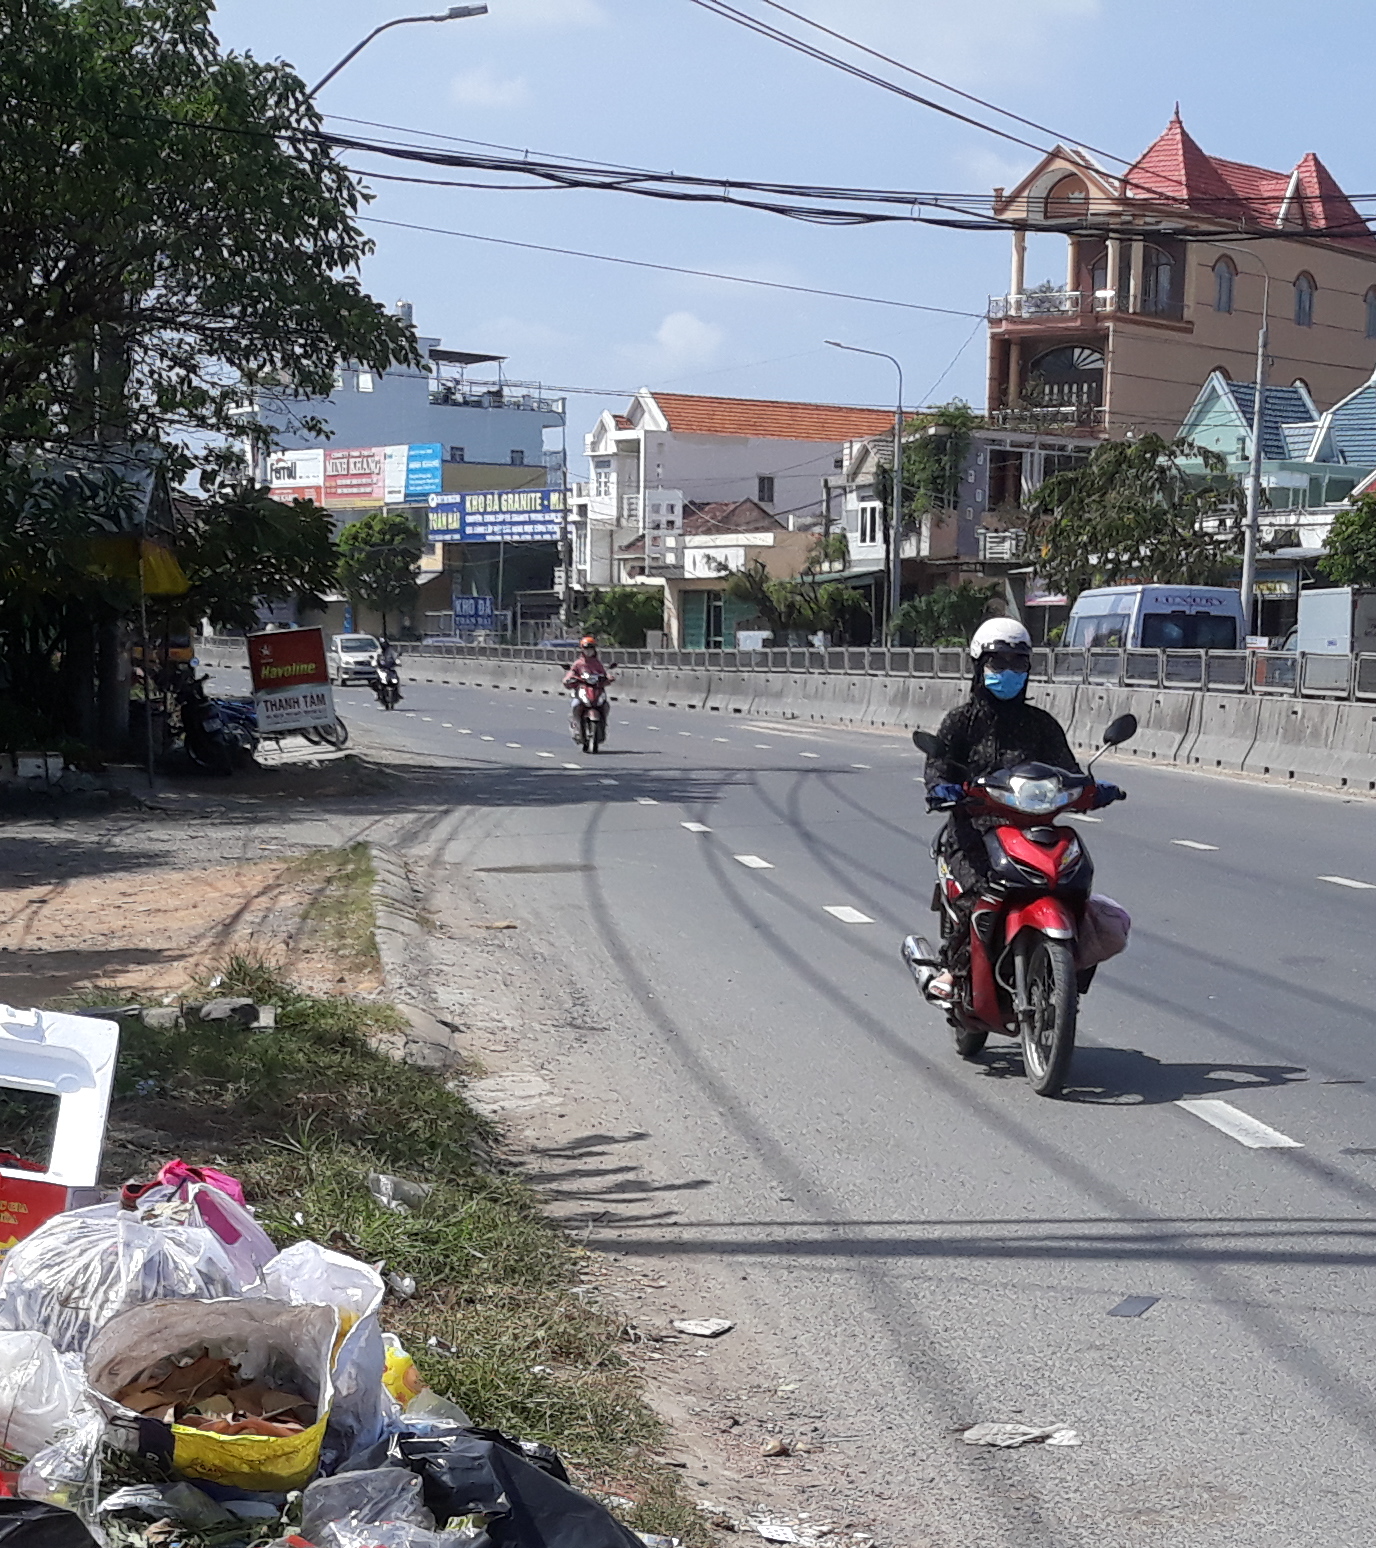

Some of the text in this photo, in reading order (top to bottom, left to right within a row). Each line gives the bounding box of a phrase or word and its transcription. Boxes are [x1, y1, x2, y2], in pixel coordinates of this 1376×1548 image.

[501, 492, 542, 512] GRANITE
[261, 662, 317, 679] Havoline
[263, 697, 301, 713] THANH
